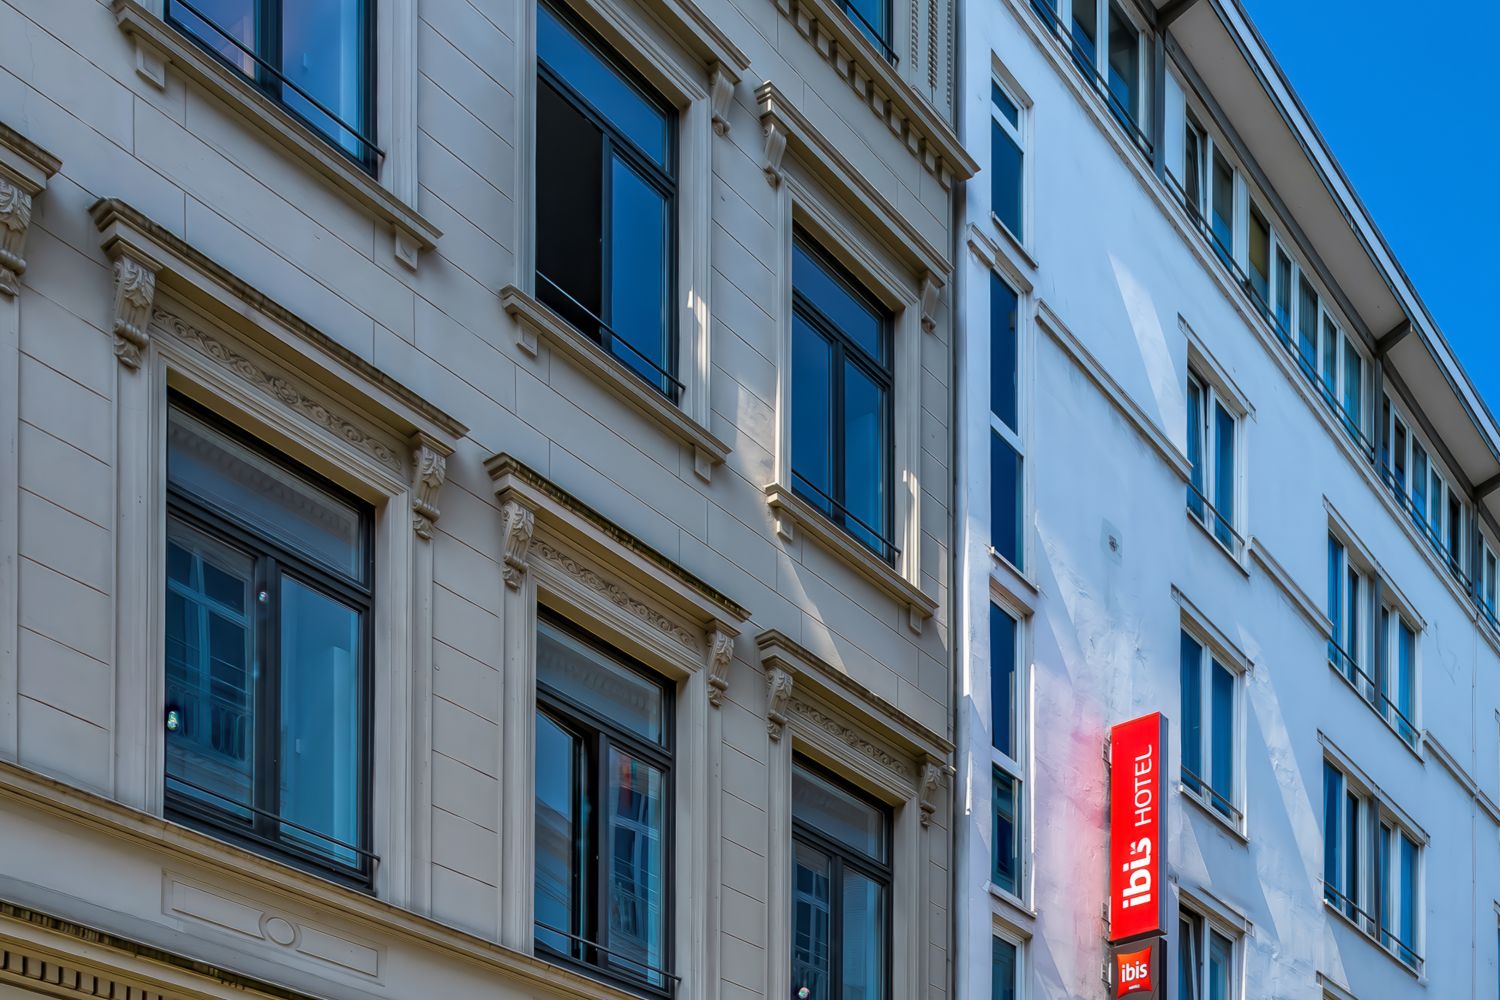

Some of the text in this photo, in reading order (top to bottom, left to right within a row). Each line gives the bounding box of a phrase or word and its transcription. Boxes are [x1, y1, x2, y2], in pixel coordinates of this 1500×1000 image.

[1122, 744, 1153, 909] ibis HOTEL
[1121, 960, 1148, 983] ibis
